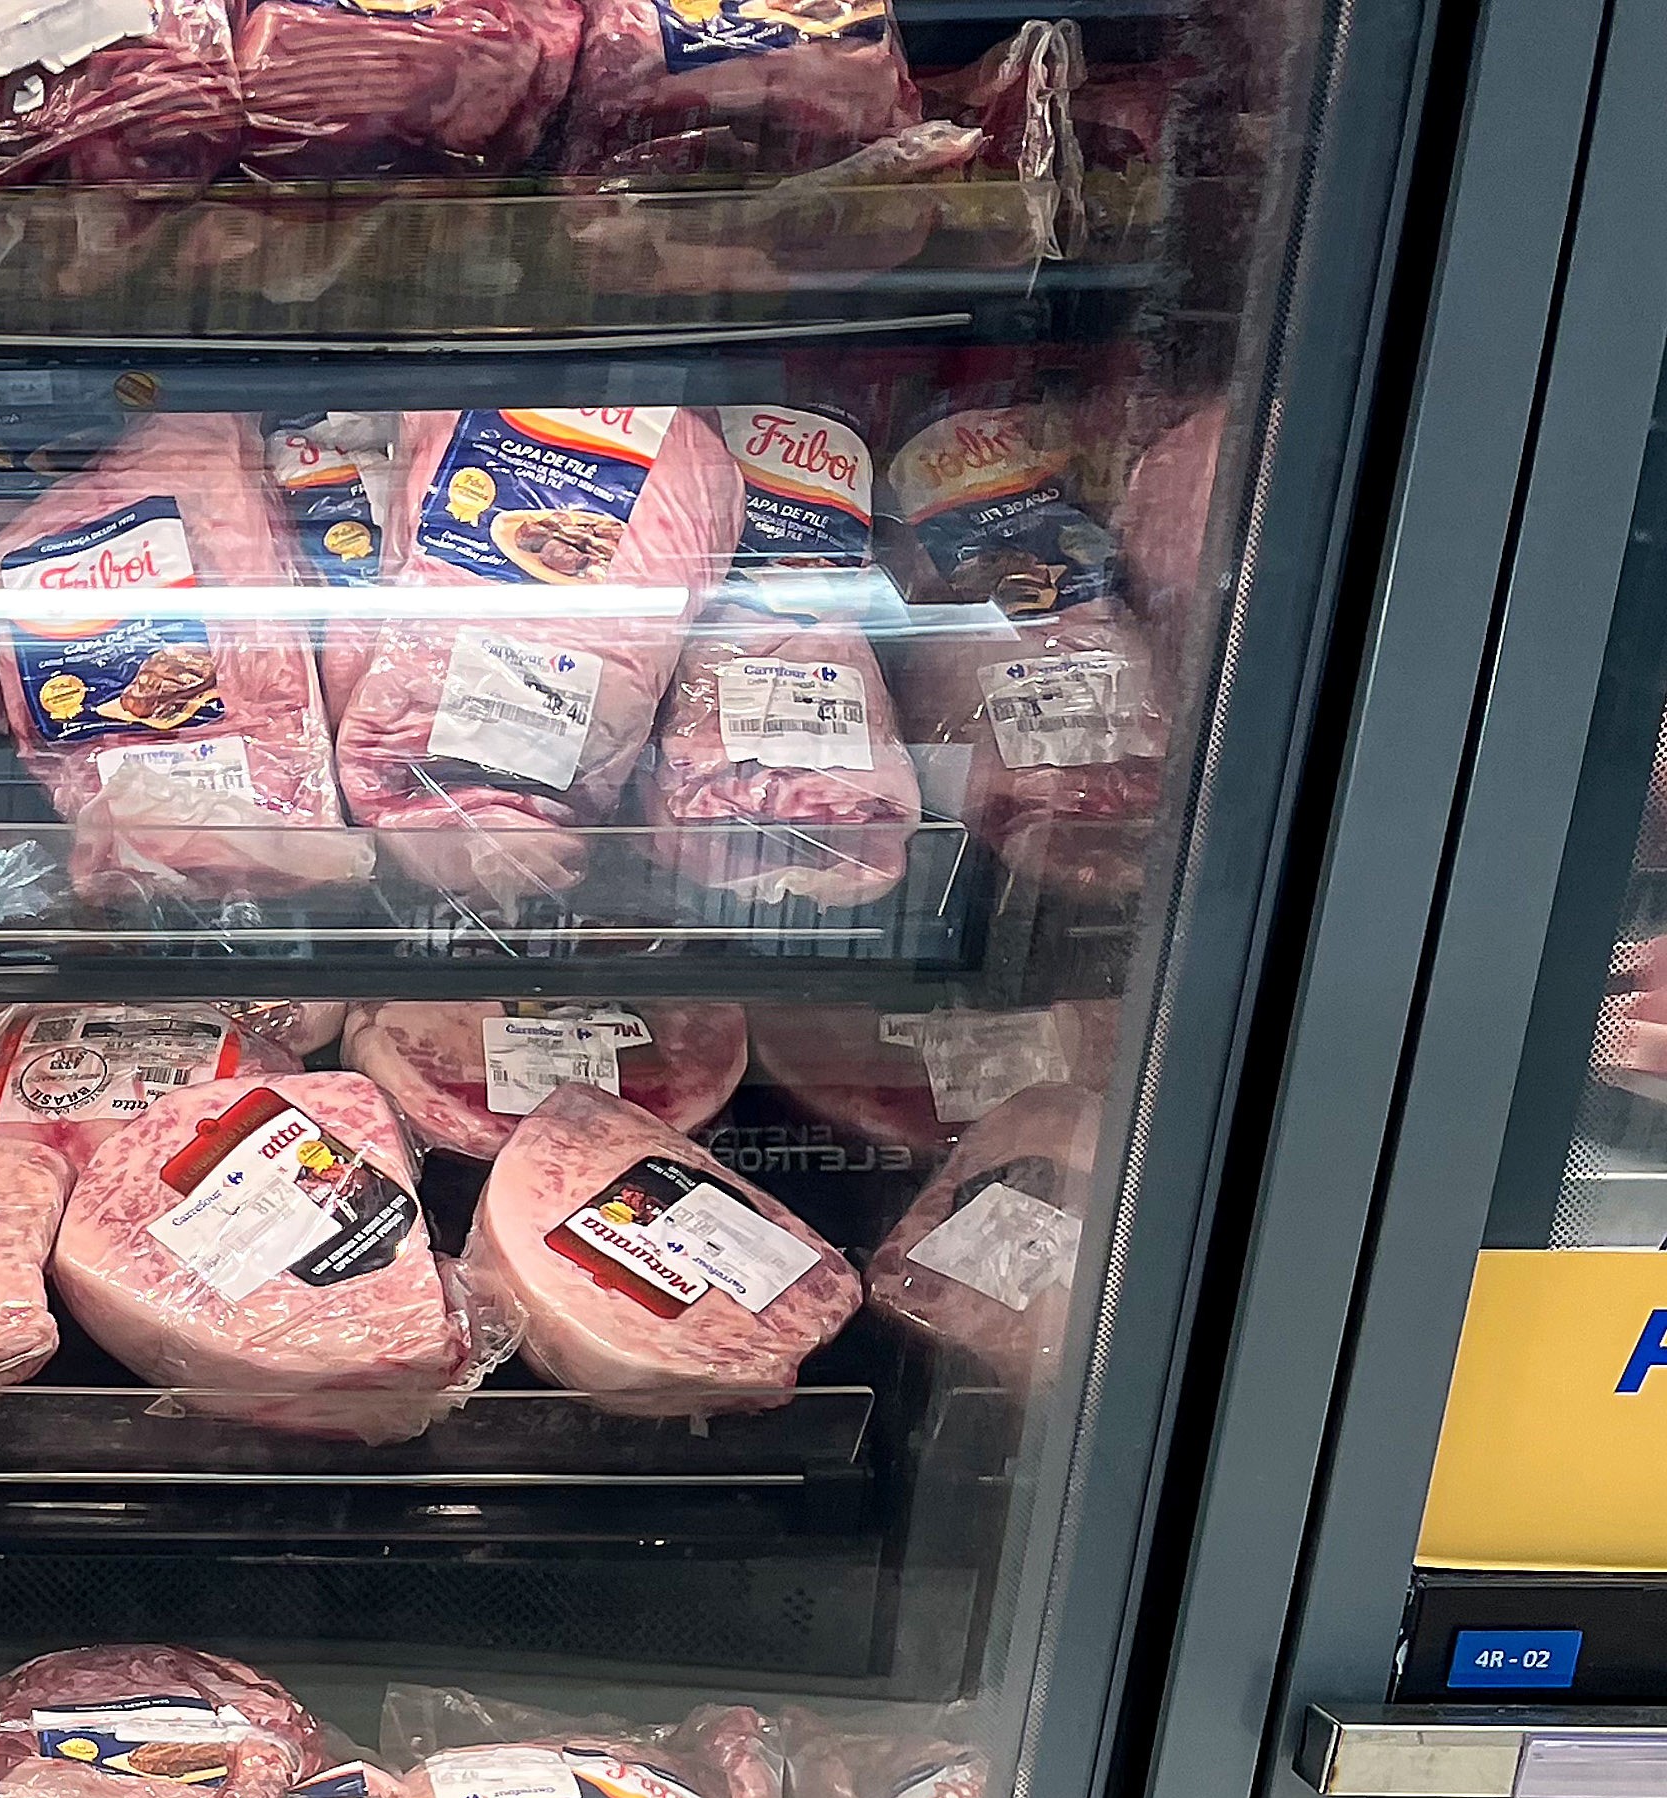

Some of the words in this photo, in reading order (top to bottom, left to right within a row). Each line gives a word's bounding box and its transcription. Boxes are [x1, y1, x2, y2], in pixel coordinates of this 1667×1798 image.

[501, 439, 542, 462] CAPA
[541, 450, 564, 468] DE
[565, 460, 599, 482] FILÉ
[745, 413, 858, 491] Friboi
[747, 495, 778, 514] APA
[780, 505, 804, 520] DE
[802, 511, 830, 529] FILÉ
[39, 540, 161, 589] Friboi
[64, 636, 105, 655] CAPA
[105, 629, 127, 643] DE
[481, 639, 546, 667] Carrefour
[744, 665, 808, 680] Carrefour
[506, 1022, 563, 1036] Carrefour
[172, 1191, 223, 1228] Carrefour
[252, 1180, 298, 1217] 81.24
[582, 1217, 694, 1297] Maturatta
[692, 1257, 747, 1296] Carrefour
[1475, 1650, 1502, 1668] 4R
[1522, 1650, 1550, 1669] 02
[494, 1786, 556, 1798] Carrefour
